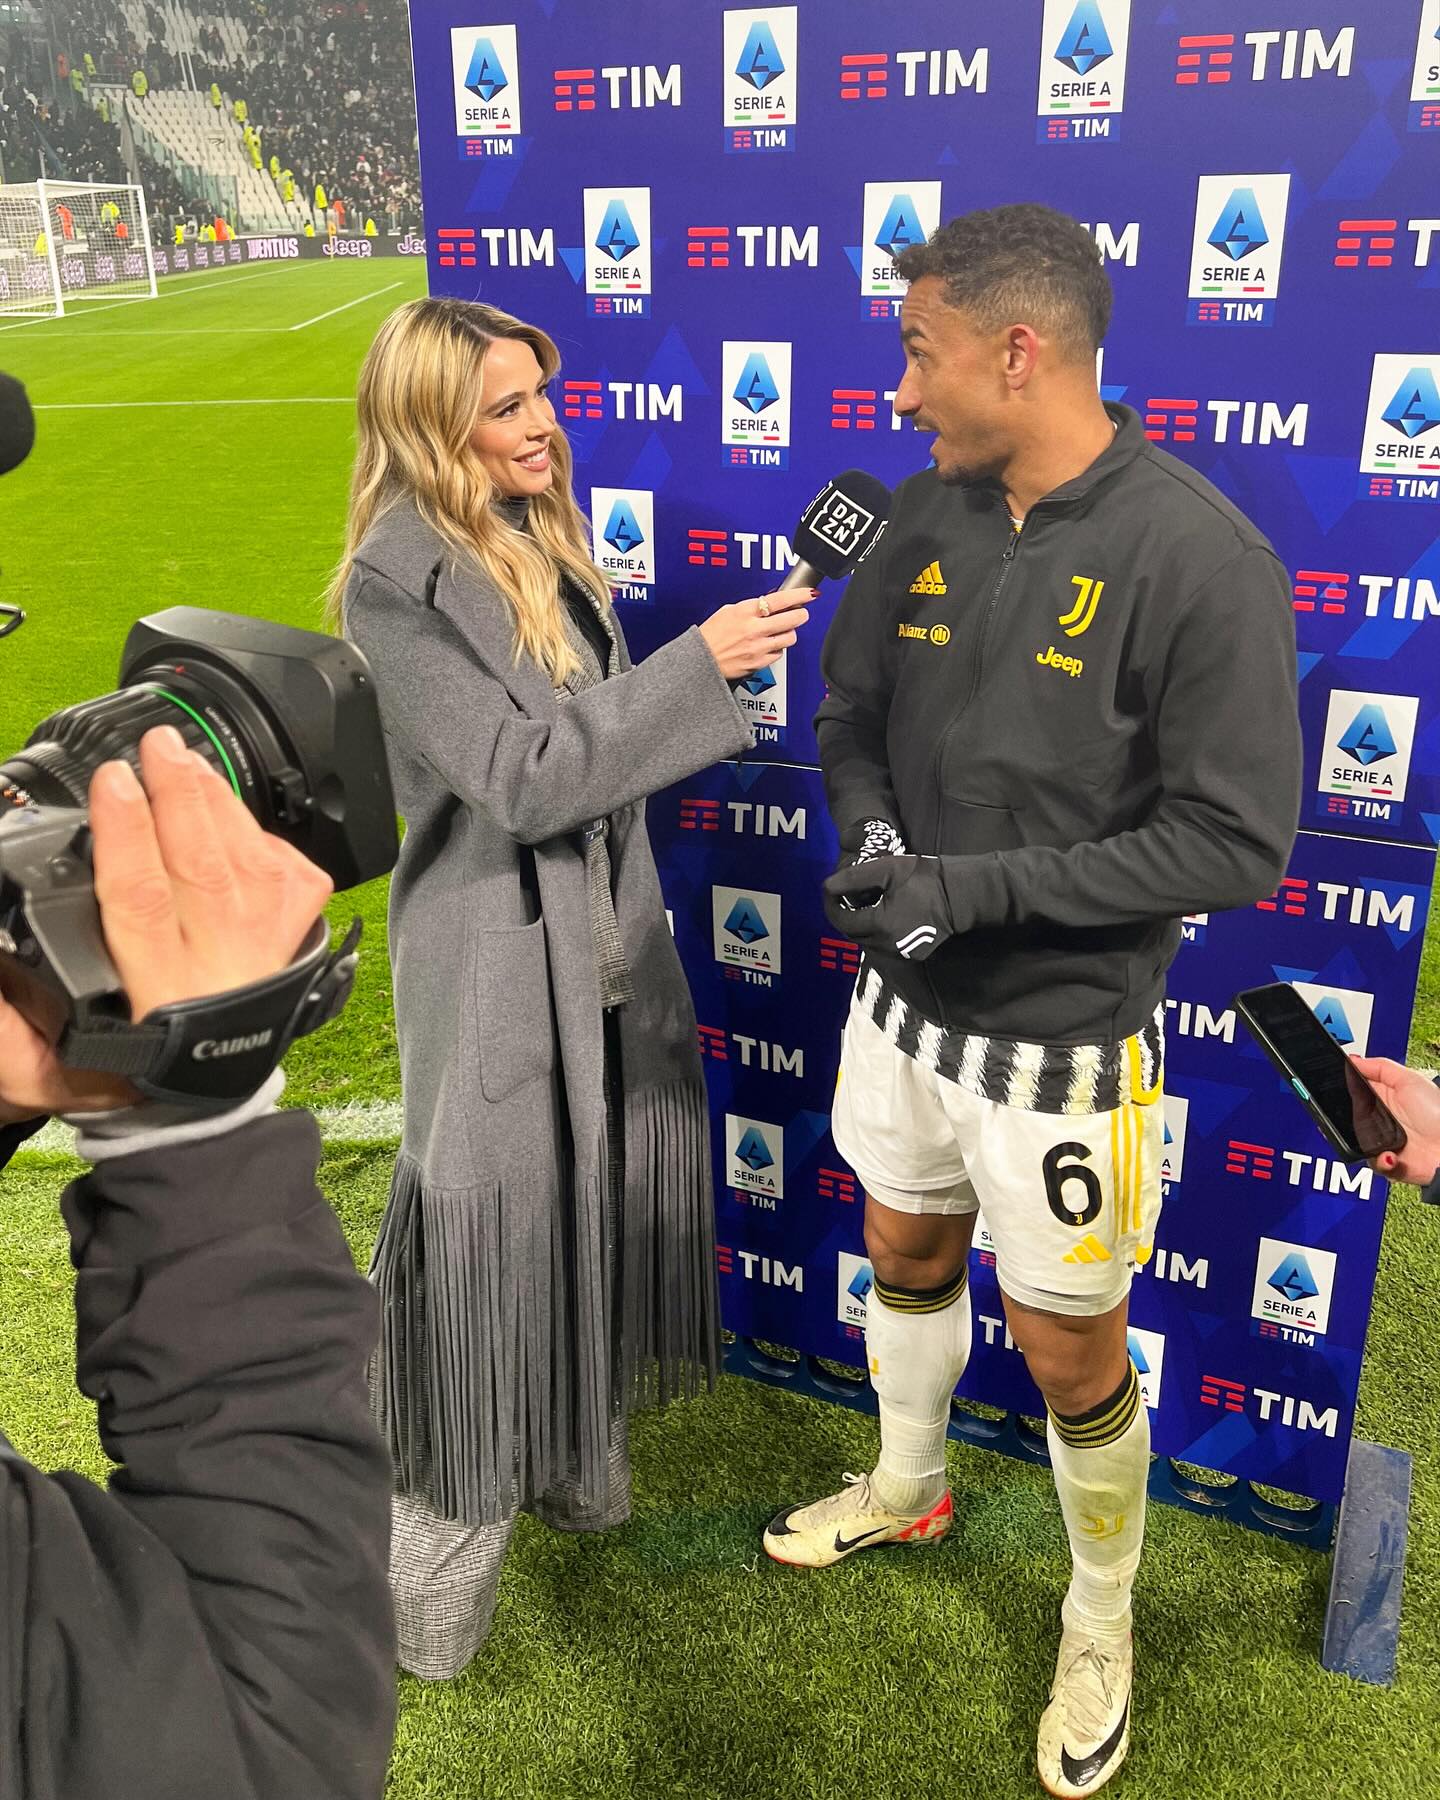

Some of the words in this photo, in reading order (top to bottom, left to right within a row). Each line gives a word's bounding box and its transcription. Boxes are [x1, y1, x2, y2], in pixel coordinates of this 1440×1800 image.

[1244, 26, 1355, 81] TIM
[896, 47, 989, 97] TIM
[601, 64, 681, 109] TIM
[1050, 81, 1097, 98] SERIE
[1099, 81, 1111, 96] A
[734, 95, 773, 111] SERIE
[775, 95, 786, 109] A
[464, 107, 499, 121] SERIE
[501, 107, 511, 121] A
[1071, 118, 1110, 138] TIM
[483, 138, 513, 155] TIM
[753, 129, 786, 148] TIM
[322, 236, 372, 258] Jeep
[480, 228, 555, 267] TIM
[737, 225, 819, 267] TIM
[594, 267, 630, 280] SERIE
[632, 267, 641, 280] A
[1202, 267, 1250, 282] SERIE
[1253, 267, 1266, 282] A
[612, 297, 643, 314] TIM
[1223, 302, 1264, 322] TIM
[608, 382, 683, 422] TIM
[731, 418, 768, 432] SERIE
[770, 420, 780, 432] A
[1207, 400, 1309, 447] TIM
[749, 448, 781, 466] TIM
[1375, 443, 1426, 459] SERIE
[1428, 445, 1440, 460] A
[1396, 479, 1439, 499] TIM
[602, 557, 635, 570] SERIE
[637, 560, 646, 571] A
[908, 580, 948, 595] adidas
[1036, 645, 1083, 678] Jeep
[741, 699, 766, 712] ERIE
[769, 702, 778, 713] A
[1331, 767, 1379, 785] SERIE
[1381, 773, 1394, 787] A
[1351, 799, 1391, 820] TIM
[727, 801, 806, 840] TIM
[1317, 882, 1415, 932] TIM
[723, 943, 759, 959] SERIE
[761, 951, 771, 962] A
[741, 969, 772, 988] TIM
[192, 1029, 272, 1061] Canon
[732, 1033, 804, 1078] TIM
[734, 1169, 765, 1185] SERIE
[766, 1178, 776, 1188] A
[1042, 1141, 1103, 1227] 6
[1282, 1150, 1374, 1201] TIM
[749, 1194, 776, 1211] TIM
[737, 1250, 803, 1293] TIM
[1262, 1299, 1304, 1318] SERIE
[1306, 1310, 1317, 1321] A
[1280, 1327, 1315, 1347] TIM
[1253, 1388, 1339, 1438] TIM
